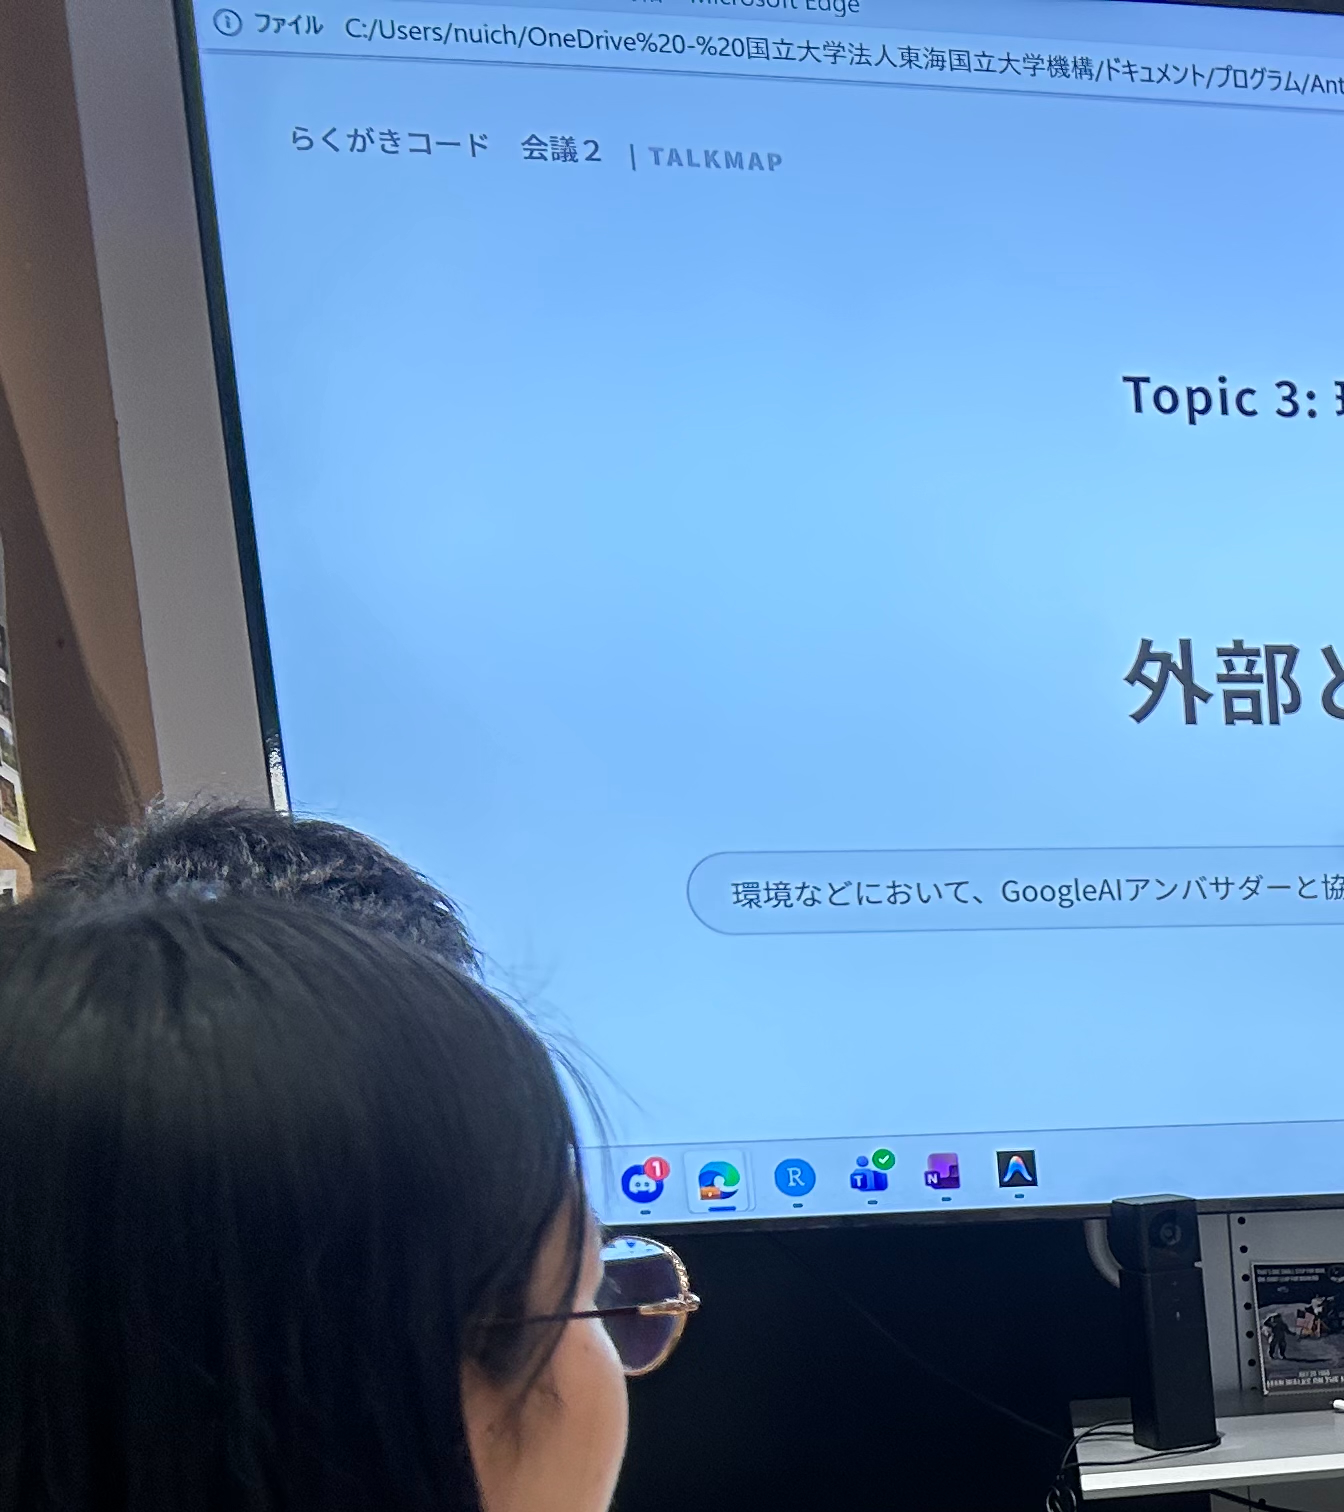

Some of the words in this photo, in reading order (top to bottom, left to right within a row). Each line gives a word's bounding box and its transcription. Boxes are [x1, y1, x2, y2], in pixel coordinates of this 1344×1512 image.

[254, 12, 324, 35] ファイル
[807, 0, 860, 18] Edge
[290, 124, 490, 158] らくがきコード
[648, 145, 783, 172] TALKMAP
[1122, 375, 1258, 425] Topic
[1274, 380, 1318, 419] 3:
